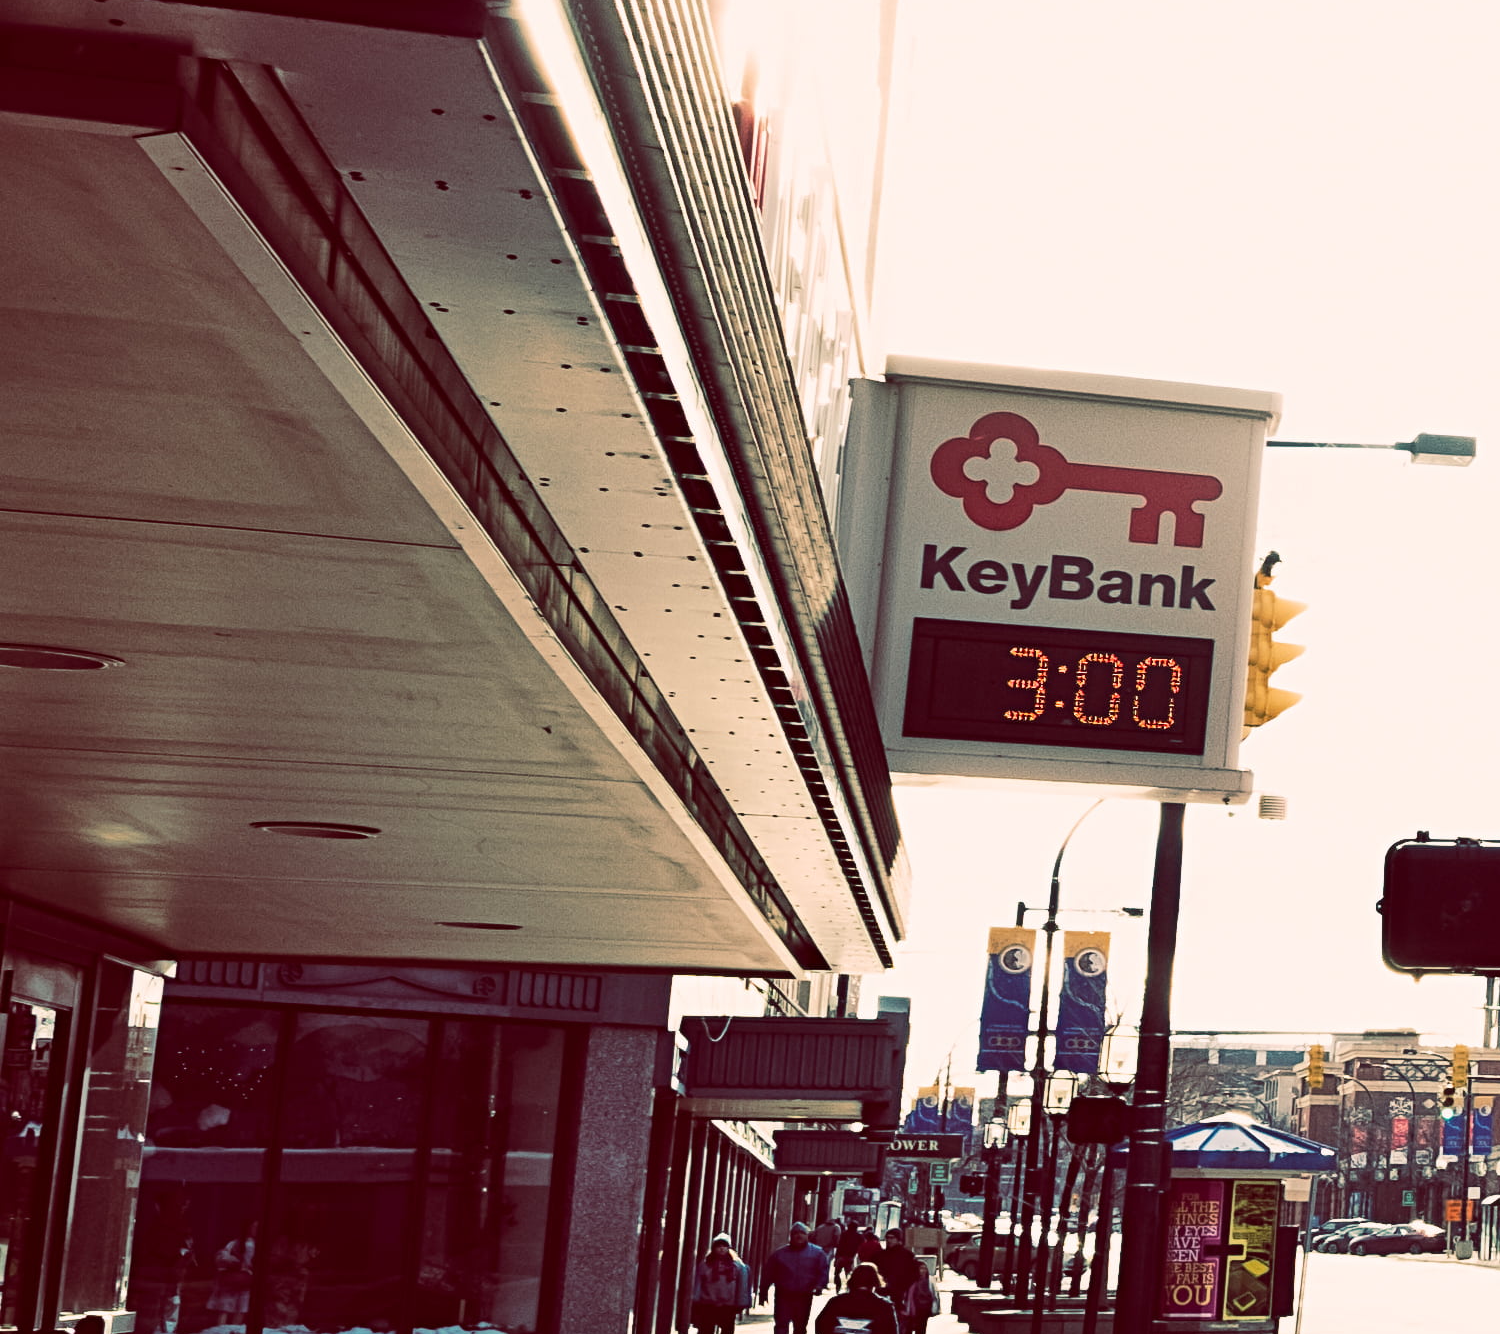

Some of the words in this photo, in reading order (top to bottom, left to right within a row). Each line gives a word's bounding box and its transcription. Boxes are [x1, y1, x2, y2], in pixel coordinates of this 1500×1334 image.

[919, 543, 1217, 611] KeyBank
[1003, 646, 1182, 730] 3:00
[887, 1139, 939, 1151] OWER
[1192, 1201, 1220, 1213] THE
[1184, 1225, 1218, 1236] EYES
[1184, 1263, 1216, 1273] BEST
[1176, 1274, 1199, 1284] FAR
[1202, 1273, 1215, 1284] IS
[1164, 1285, 1213, 1306] YOU
